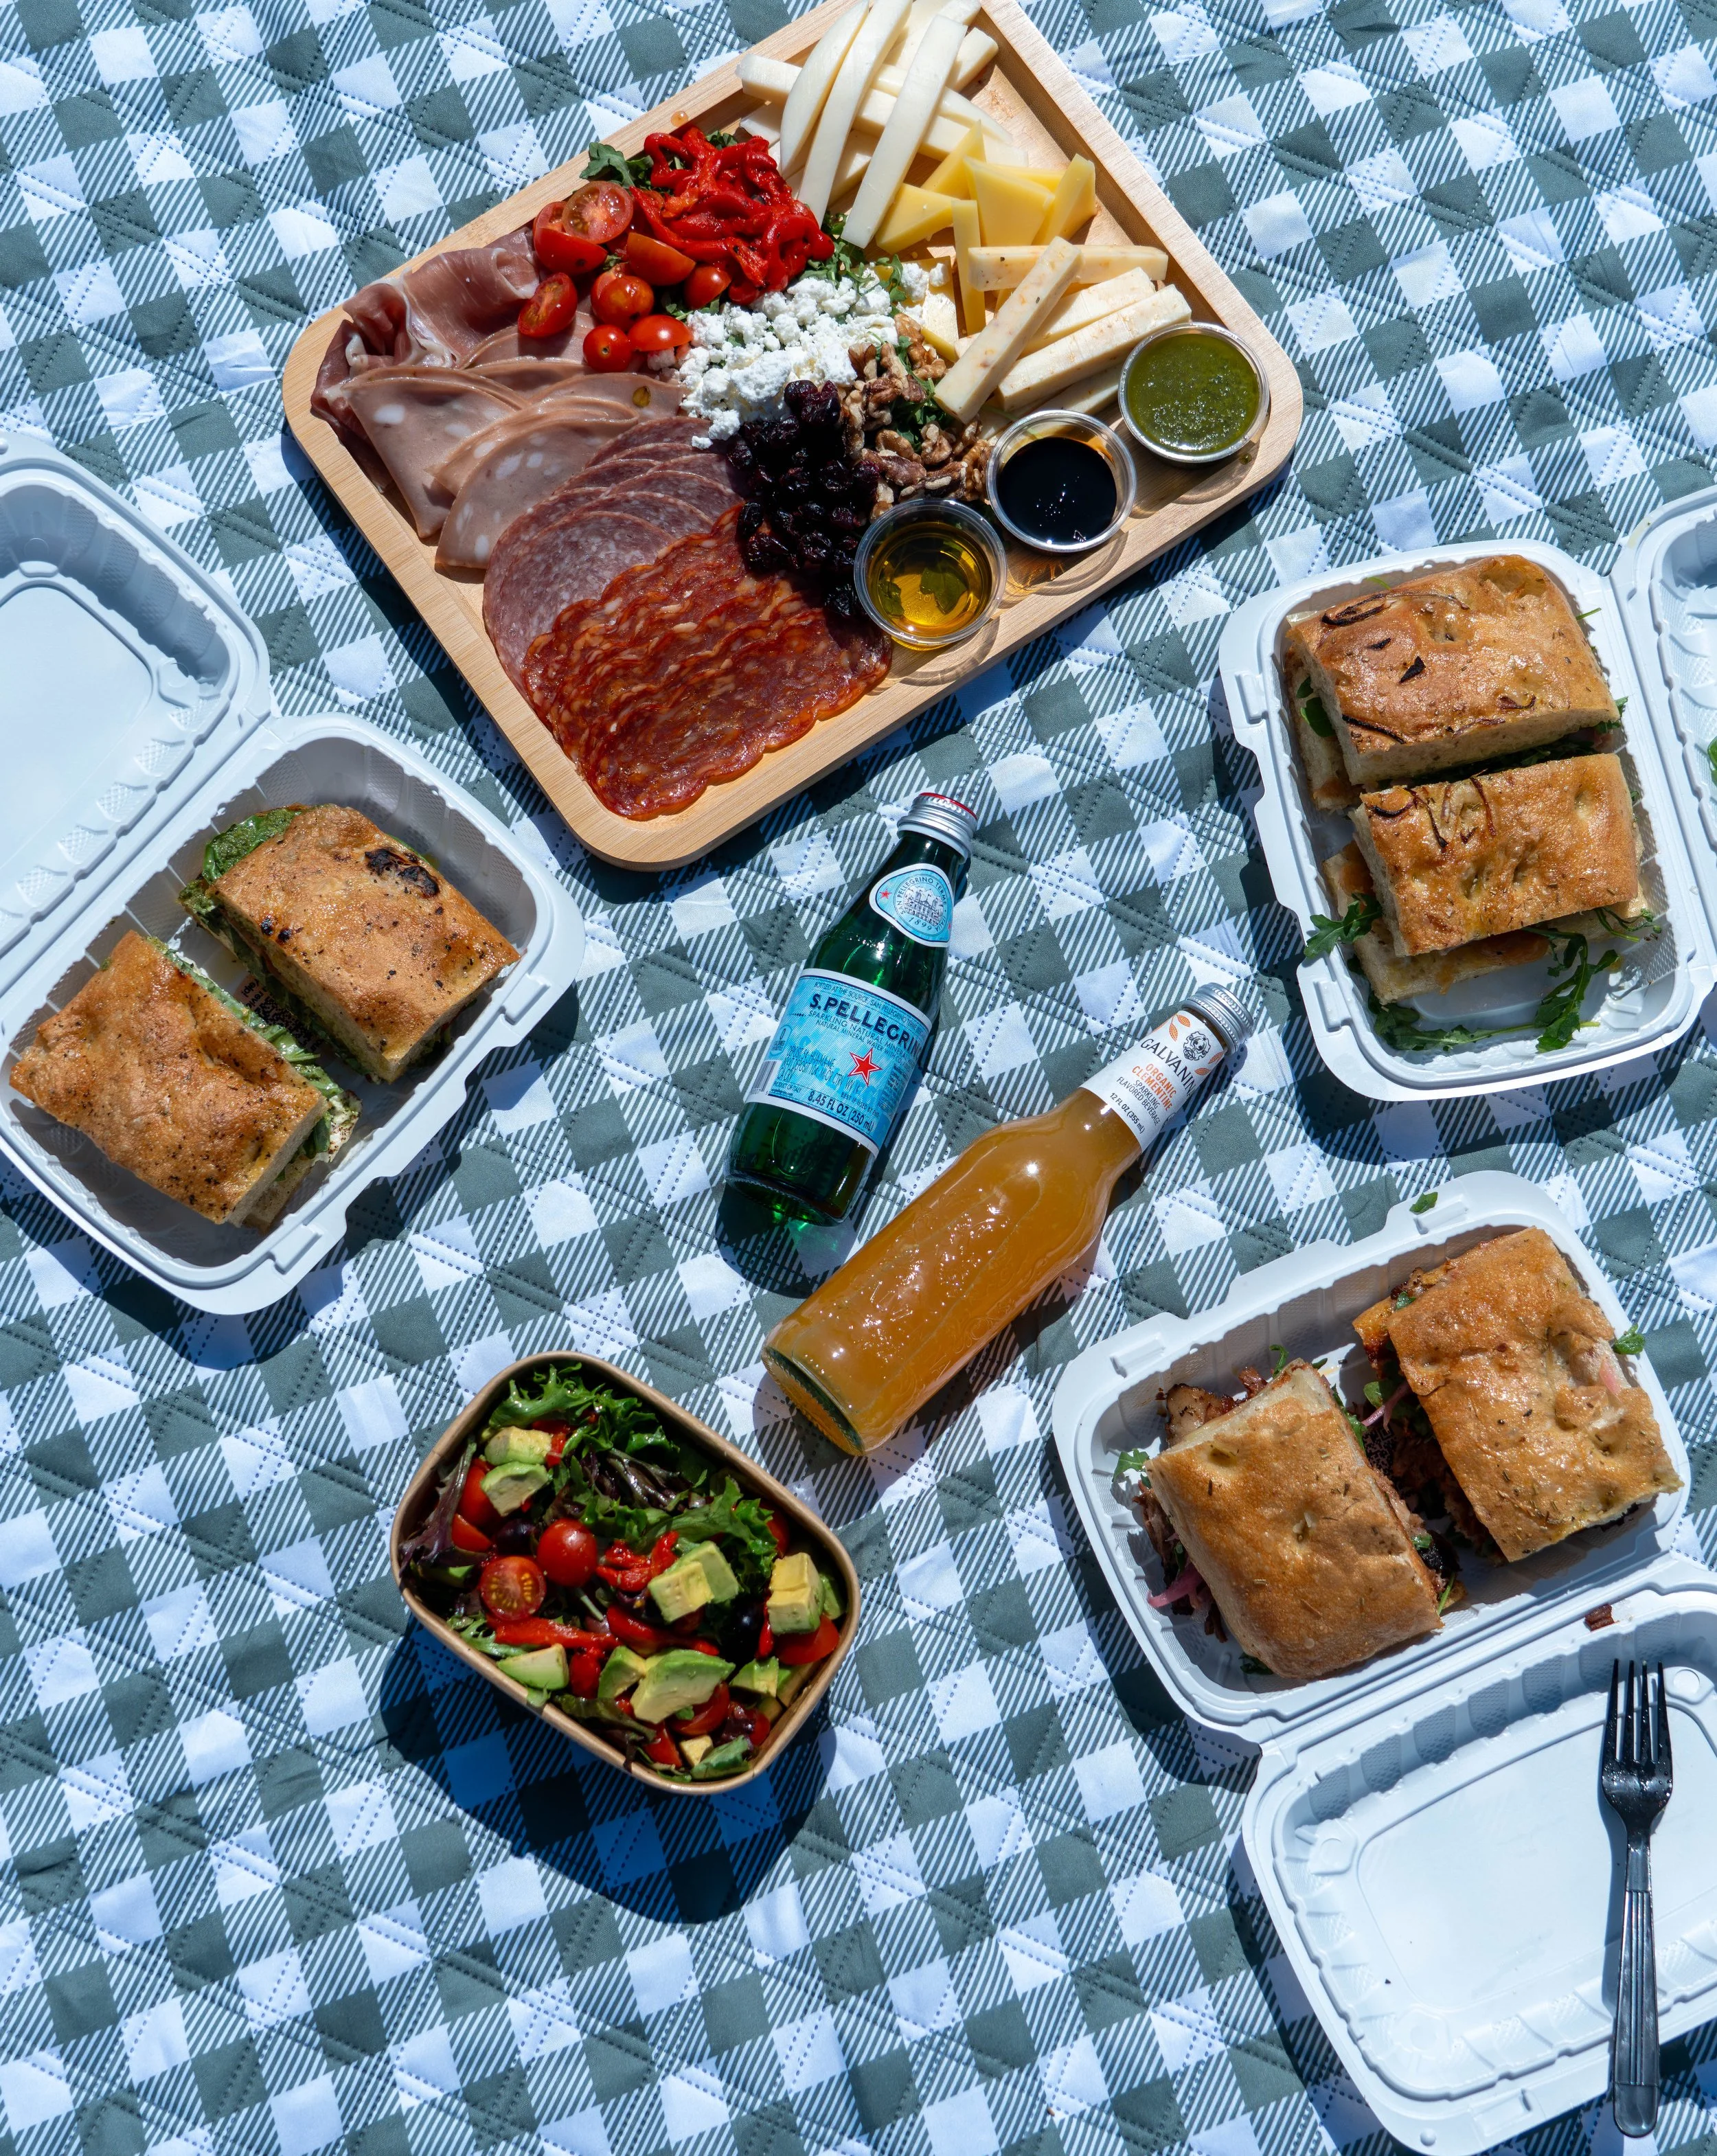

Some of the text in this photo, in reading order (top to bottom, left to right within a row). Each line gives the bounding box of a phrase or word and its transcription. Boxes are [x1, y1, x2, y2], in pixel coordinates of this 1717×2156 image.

[896, 876, 947, 915] SAN PELLEGRINO TERME
[908, 917, 933, 931] 1899
[848, 990, 869, 1005] SOURCE,
[869, 998, 881, 1008] SAN
[808, 1010, 848, 1028] SPARKLING
[850, 1021, 884, 1044] NATURAL
[816, 1020, 840, 1032] NATURAL
[841, 1028, 867, 1043] MINERAL
[867, 1040, 885, 1052] WATER
[1132, 1065, 1173, 1111] CLEMENTINE
[1133, 1079, 1161, 1110] SPARKLING
[1145, 1063, 1177, 1098] ORGANIC
[808, 1091, 827, 1106] 8.45
[826, 1098, 835, 1111] FL
[837, 1103, 850, 1117] OZ
[848, 1108, 865, 1126] (250
[841, 1091, 852, 1102] BEST
[856, 1099, 867, 1111] USED
[1110, 1092, 1146, 1134] 12 FL OZ (355 mL)
[1116, 1076, 1161, 1126] FLAVORED BEVERAGE
